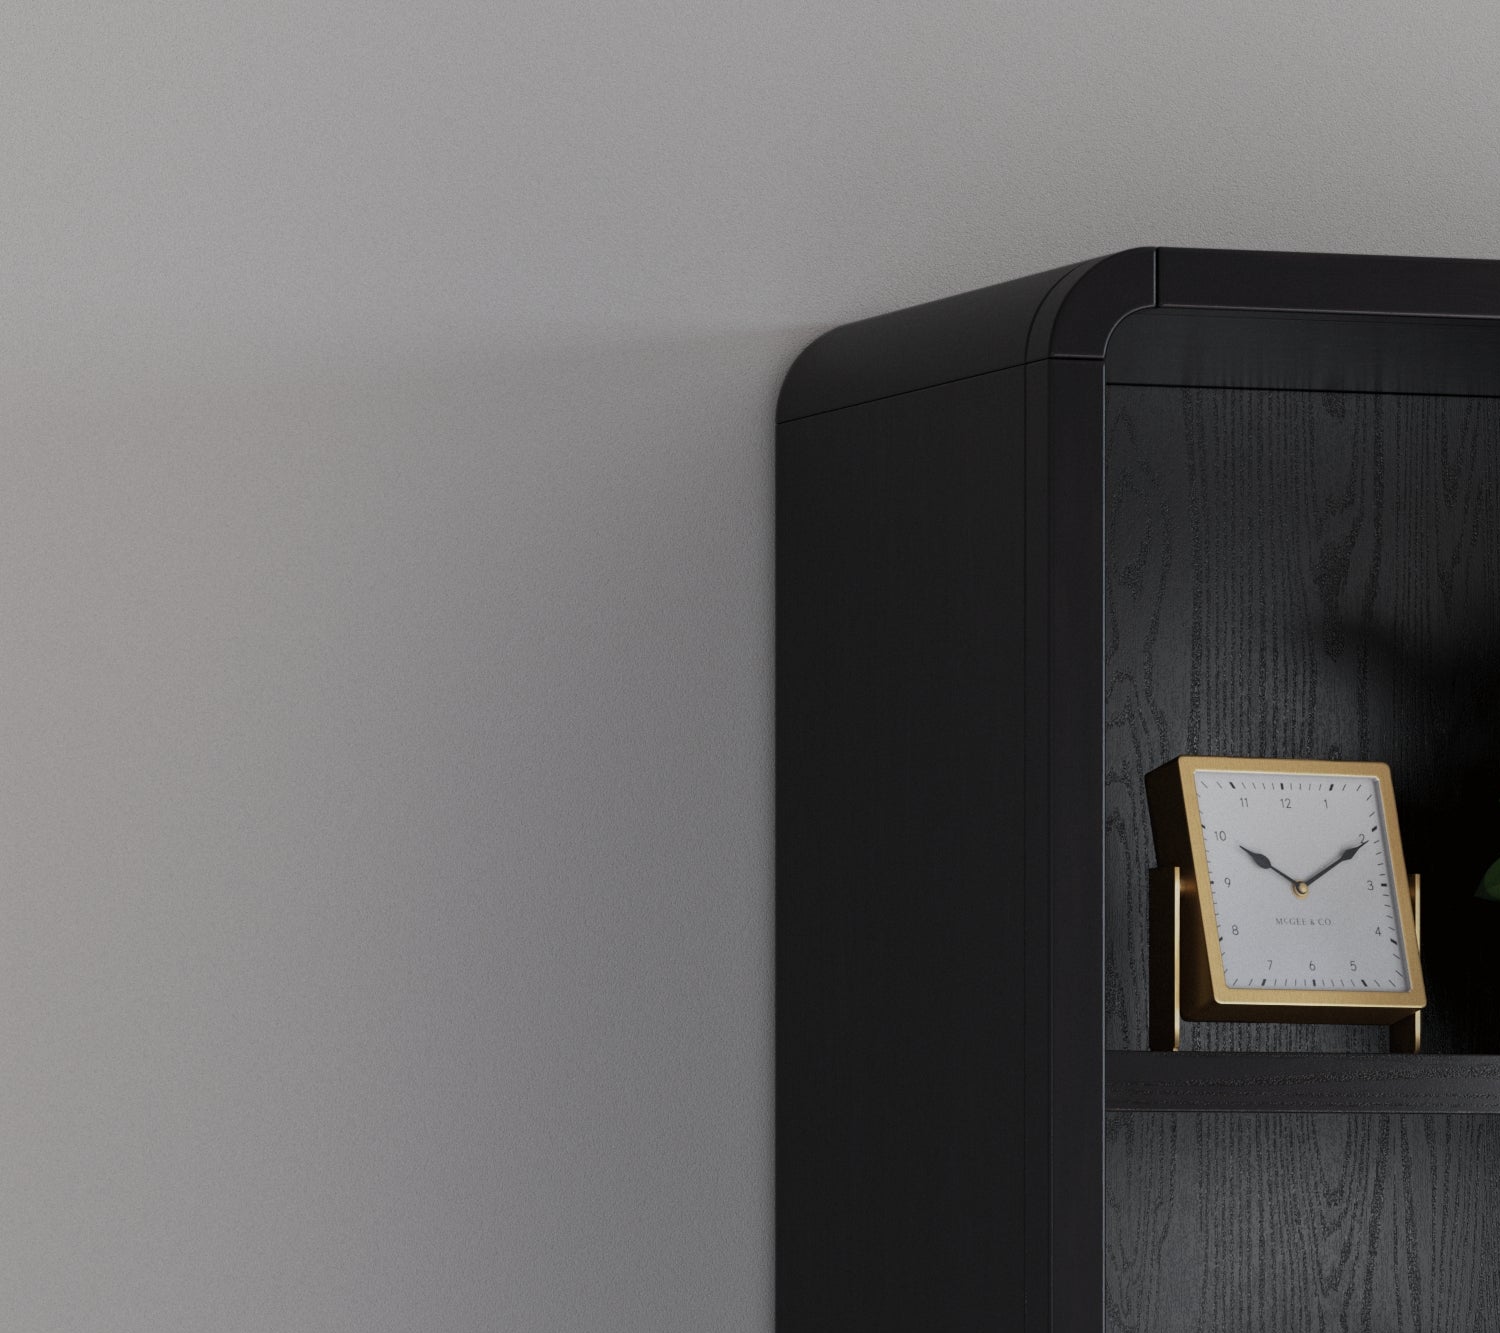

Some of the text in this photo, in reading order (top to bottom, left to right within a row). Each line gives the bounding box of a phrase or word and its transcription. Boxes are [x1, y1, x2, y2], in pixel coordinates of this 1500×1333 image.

[1240, 798, 1248, 808] 11
[1280, 798, 1292, 809] 12
[1214, 831, 1227, 842] 10
[1224, 877, 1231, 888] 9
[1367, 880, 1374, 891] 3
[1232, 925, 1239, 936] 8
[1374, 926, 1381, 937] 4
[1267, 960, 1273, 970] 7
[1309, 960, 1316, 971] 6
[1350, 960, 1357, 971] 5
